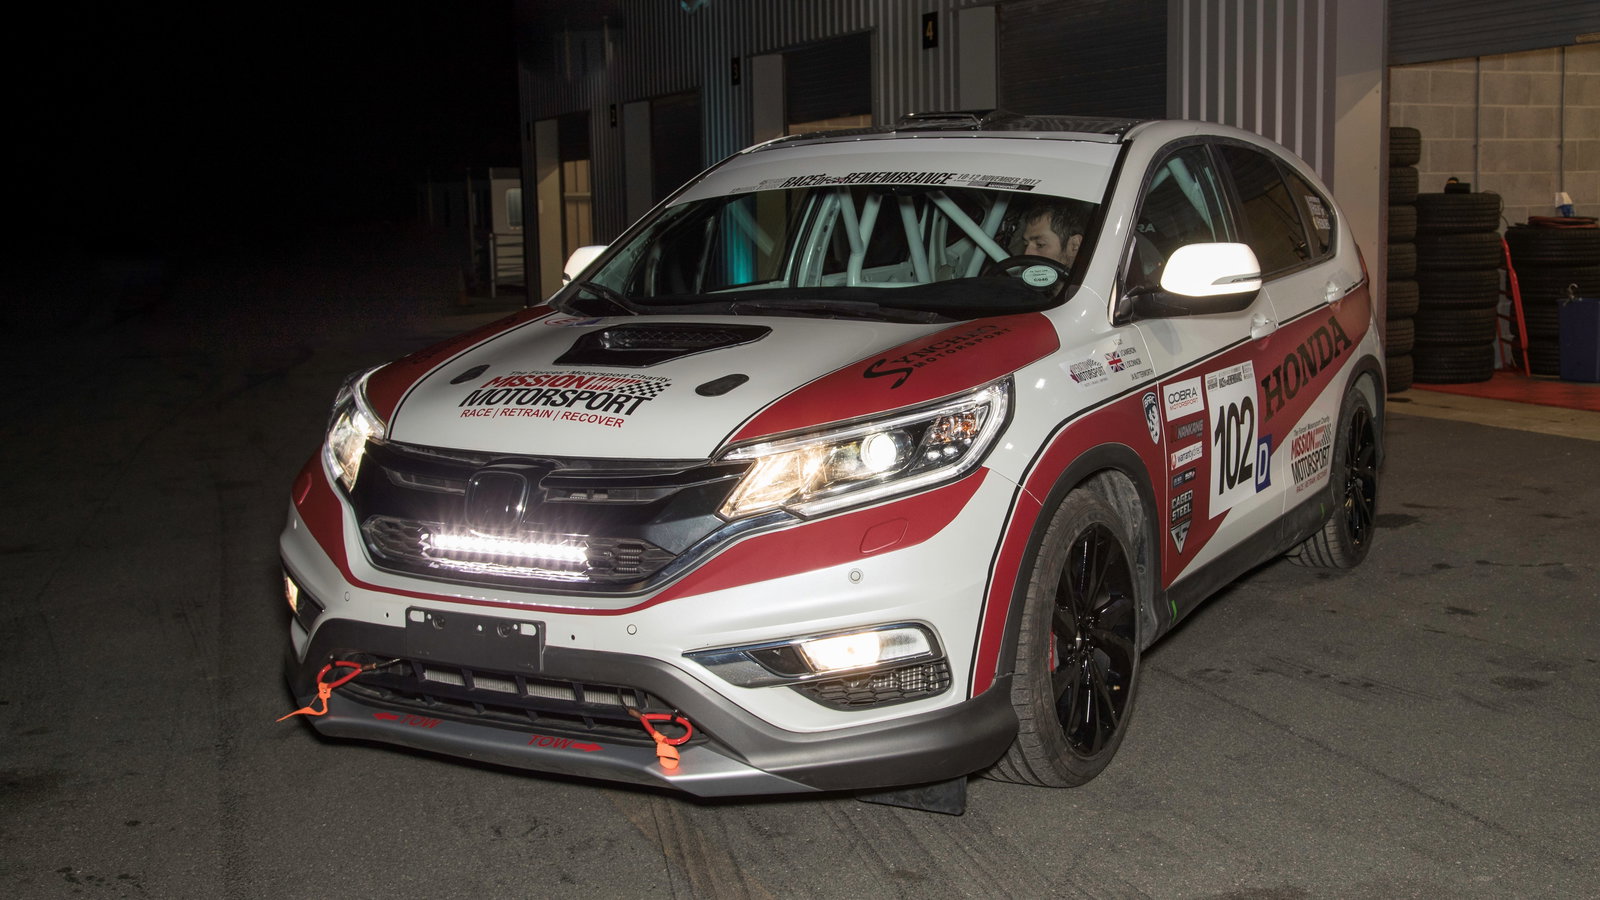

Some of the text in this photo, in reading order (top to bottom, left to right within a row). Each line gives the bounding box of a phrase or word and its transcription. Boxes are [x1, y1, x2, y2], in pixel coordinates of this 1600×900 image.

[926, 20, 934, 40] 4
[914, 328, 1012, 368] MOTORSPORT
[630, 374, 672, 383] Charity
[1261, 315, 1352, 423] HONDA
[480, 375, 595, 390] MISSION
[458, 388, 653, 416] MOTORSPORT
[1168, 387, 1198, 404] COBRA
[460, 408, 625, 428] RACE RETRAIN RECOVER
[1214, 396, 1254, 495] 102
[1258, 442, 1268, 484] D
[1172, 490, 1192, 508] CAGED
[1172, 502, 1192, 522] STEEL
[401, 714, 443, 728] TOW
[528, 735, 574, 749] TOW
